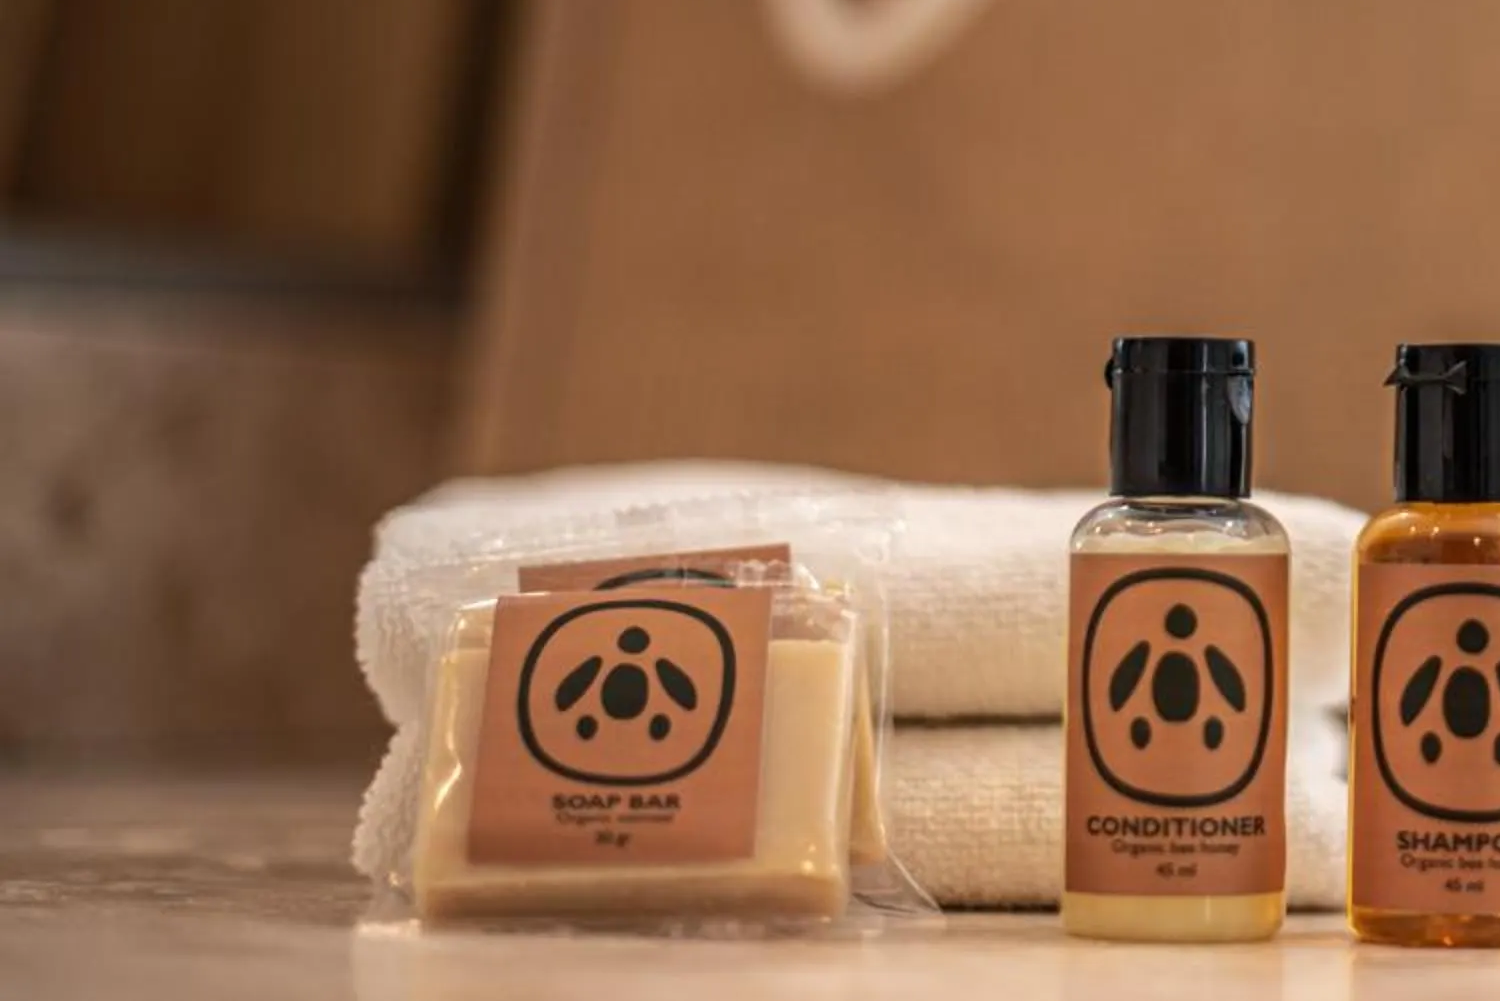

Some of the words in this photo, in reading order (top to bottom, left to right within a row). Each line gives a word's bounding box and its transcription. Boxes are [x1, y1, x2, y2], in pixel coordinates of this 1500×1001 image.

[551, 794, 622, 811] SOAP
[628, 793, 681, 809] BAR
[1086, 815, 1266, 837] CONDITIONER
[1111, 838, 1164, 858] Organic
[1400, 852, 1453, 872] Organic
